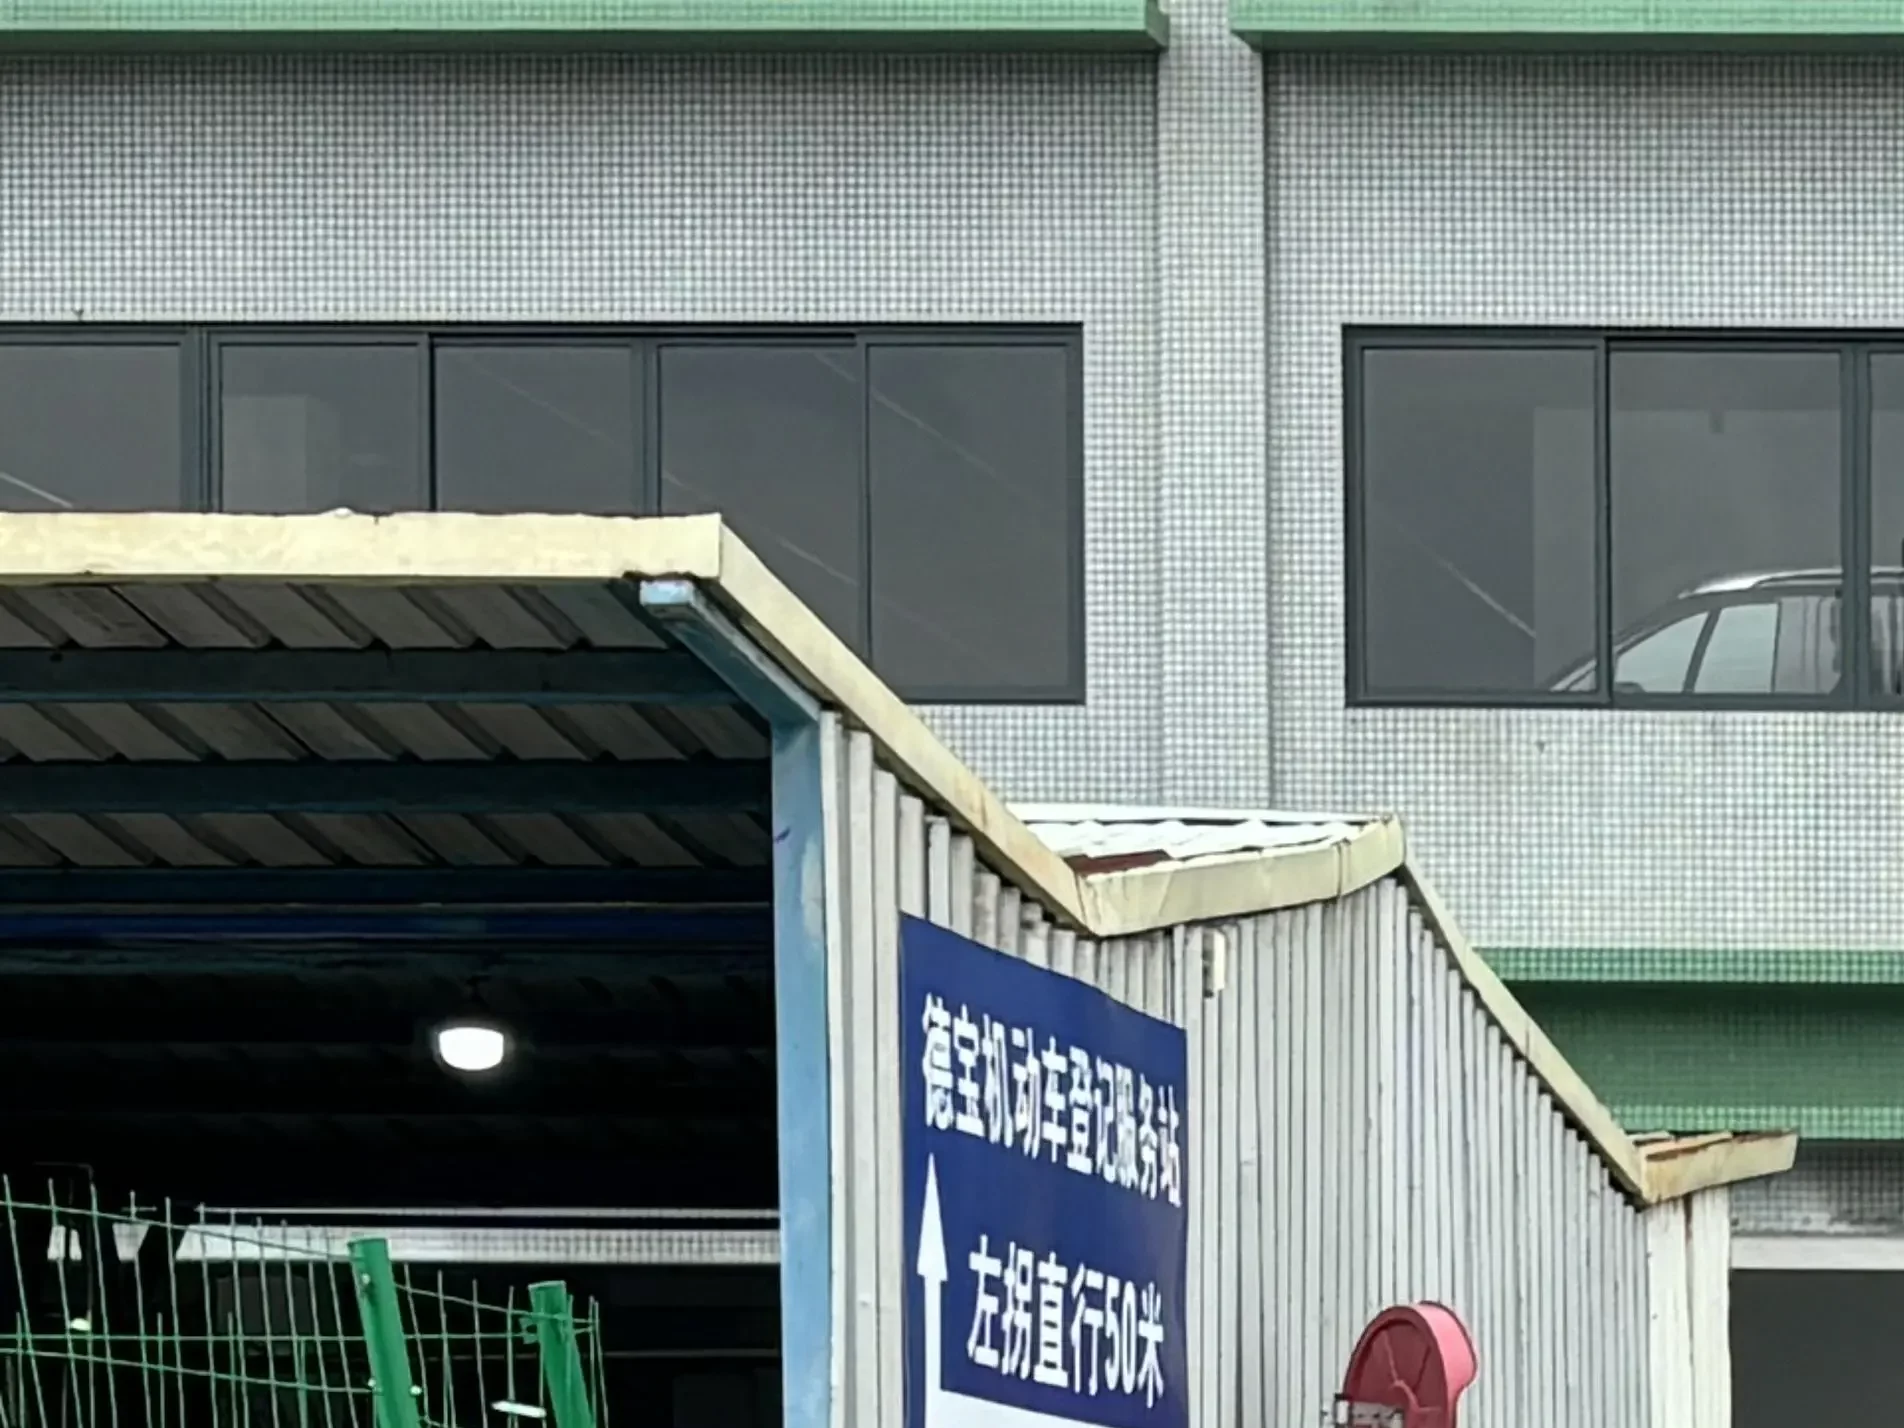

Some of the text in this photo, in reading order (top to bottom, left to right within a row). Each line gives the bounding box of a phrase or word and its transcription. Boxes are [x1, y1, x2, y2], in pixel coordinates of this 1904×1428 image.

[922, 992, 1182, 1208] 德宝机动车登记服务站
[967, 1234, 1164, 1409] 左拐直行50米
